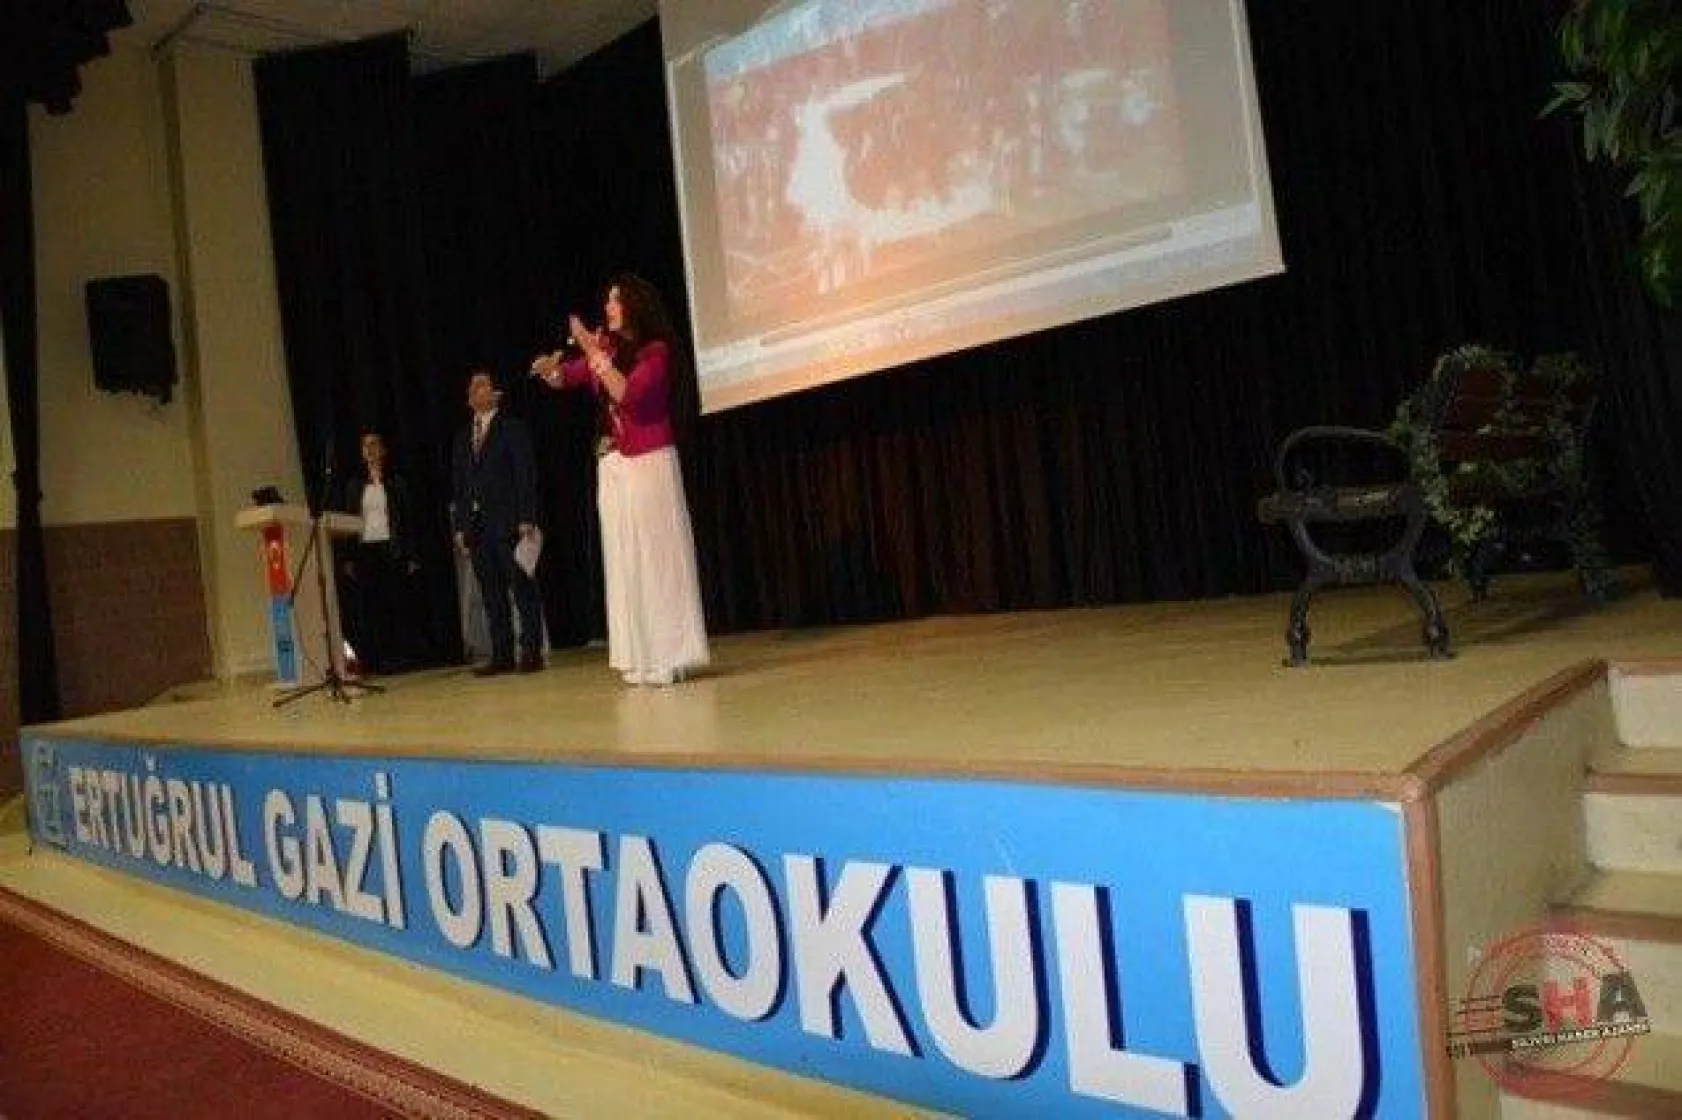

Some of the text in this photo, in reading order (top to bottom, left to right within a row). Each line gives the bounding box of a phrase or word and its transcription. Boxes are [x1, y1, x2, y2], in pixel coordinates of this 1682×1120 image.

[68, 754, 1378, 1120] ERTUĞRUL GAZİ ORTAOKULU
